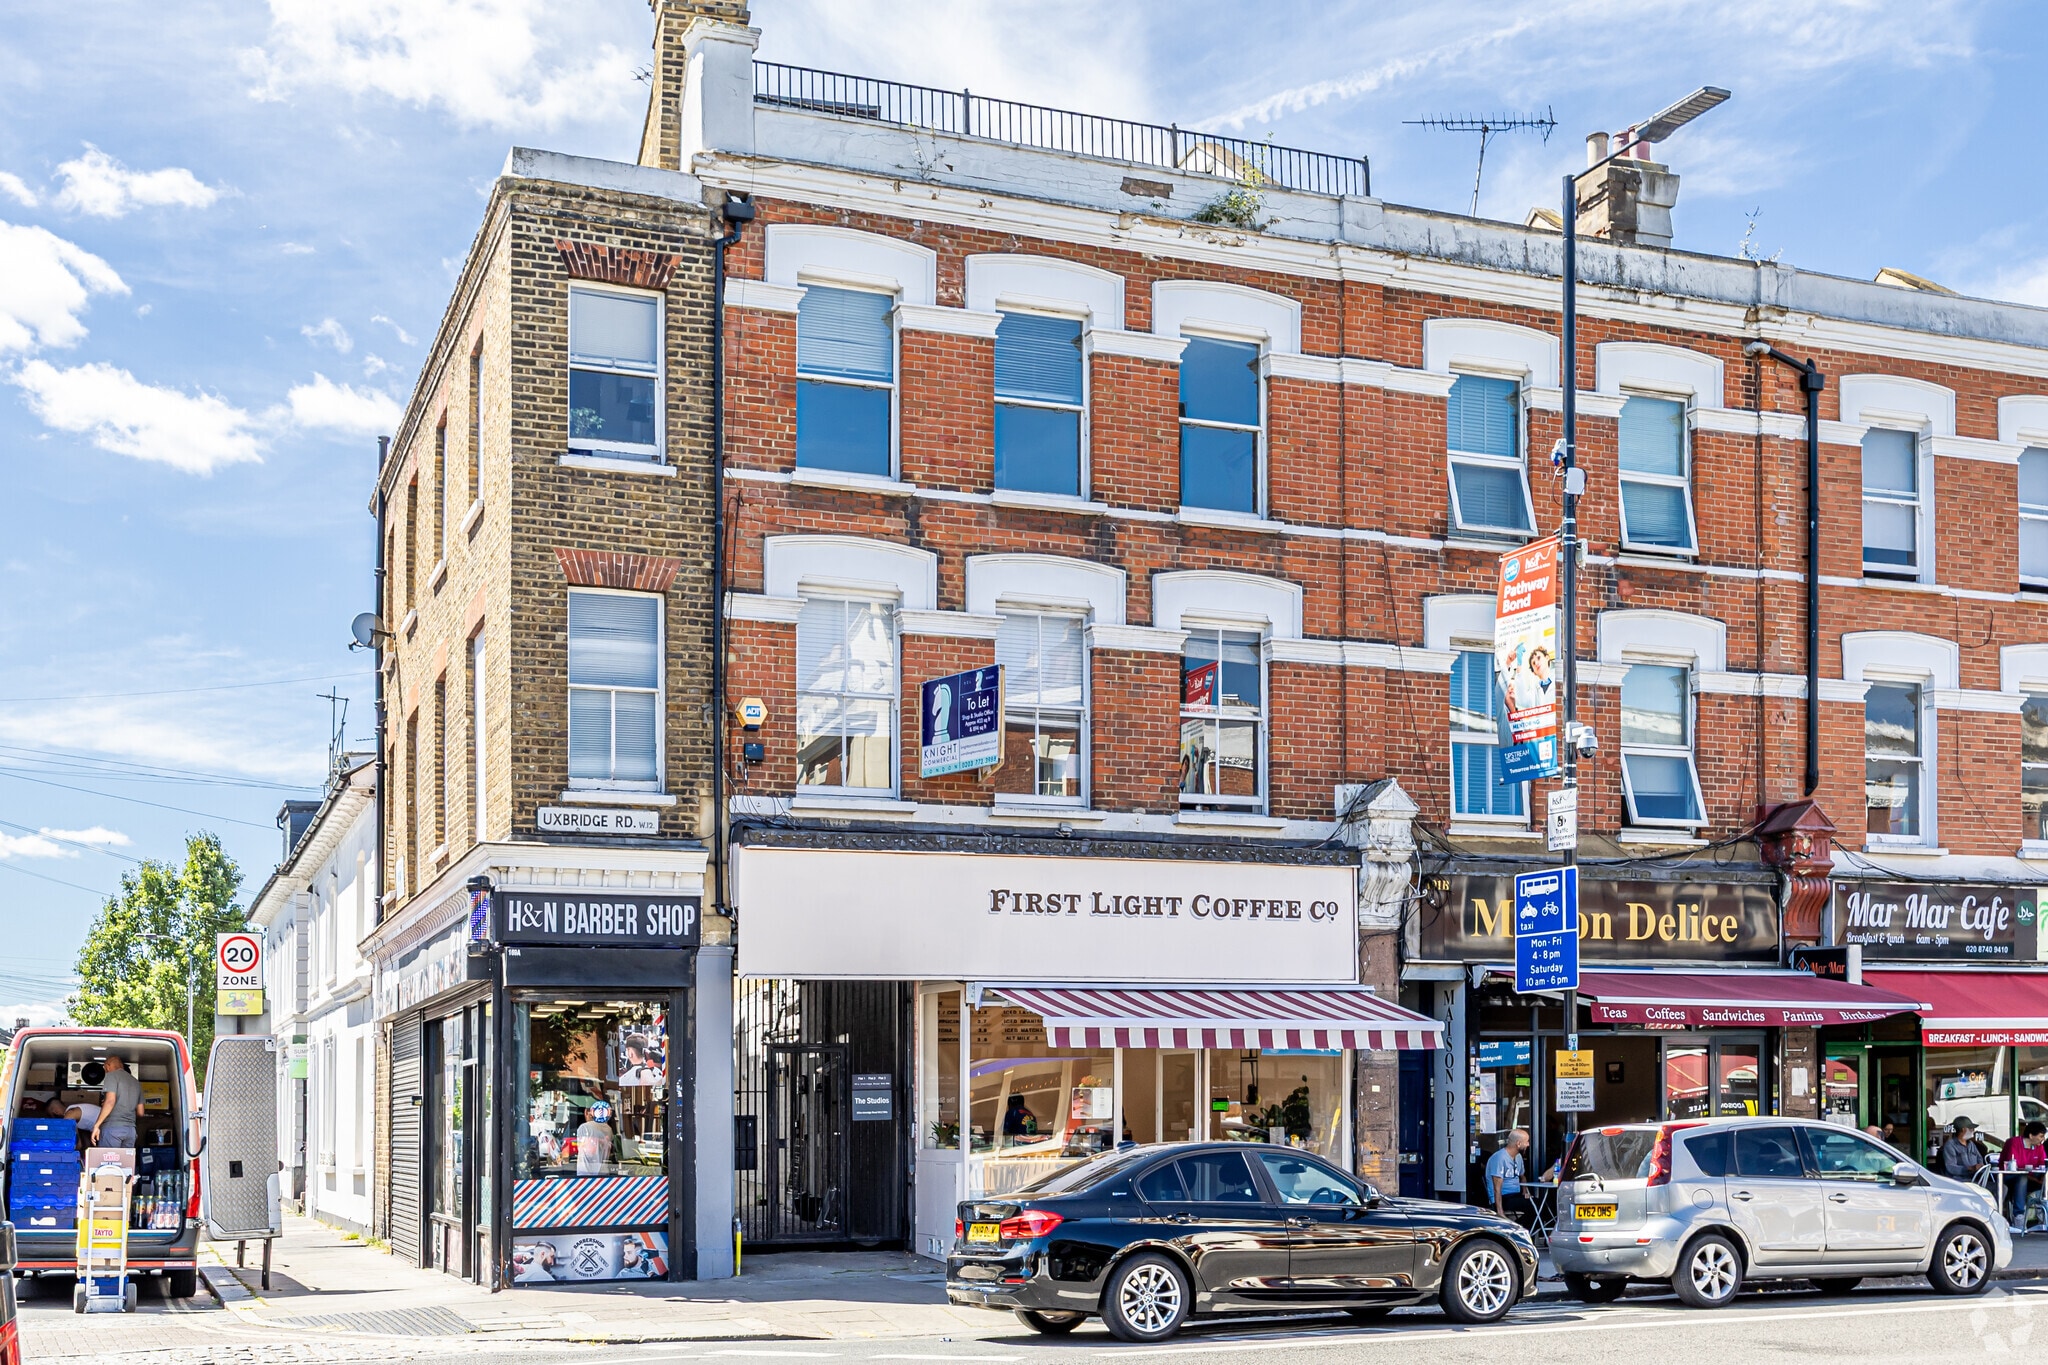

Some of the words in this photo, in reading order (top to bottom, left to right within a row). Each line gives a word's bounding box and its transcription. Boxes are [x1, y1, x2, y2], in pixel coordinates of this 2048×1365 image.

[1503, 576, 1549, 599] Pathway
[1502, 593, 1531, 613] Bond
[967, 698, 976, 710] To
[978, 695, 989, 708] Let
[746, 707, 760, 715] ADT
[924, 743, 957, 759] KNIGHT
[1504, 749, 1529, 759] UPSTREAM
[924, 755, 957, 766] COMMERCIAL
[543, 813, 608, 827] UXBRIDGE
[615, 815, 636, 828] RD.
[990, 889, 1081, 914] FIRST
[1091, 891, 1182, 916] LIGHT
[1191, 894, 1301, 919] COFFEE
[508, 900, 557, 932] H&N
[564, 902, 637, 934] BARBER
[646, 904, 695, 936] SHOP
[1625, 902, 1738, 943] Delice
[1847, 892, 1898, 927] Mar
[1905, 893, 1954, 929] Mar
[1960, 895, 2009, 940] Cafe
[1520, 921, 1534, 930] taxi
[1531, 939, 1547, 948] Mon
[1552, 936, 1562, 945] Fri
[1846, 932, 1878, 946] Breakfast
[1880, 933, 1885, 943] &
[1886, 932, 1904, 946] Lunch
[1916, 933, 1930, 945] 6am
[1935, 934, 1949, 947] 5pm
[226, 948, 253, 962] 20
[1532, 951, 1538, 960] 4
[1543, 950, 1548, 959] 8
[1549, 951, 1560, 960] pm
[1978, 945, 1993, 953] 8740
[1530, 963, 1563, 974] Saturday
[1828, 961, 1845, 974] Mar
[223, 976, 258, 985] ZONE
[1525, 978, 1534, 987] 10
[1551, 975, 1556, 984] 6
[1557, 976, 1568, 986] pm
[1600, 1006, 1628, 1019] Teas
[1645, 1007, 1686, 1020] Coffees
[1702, 1008, 1765, 1022] Sandwiches
[1782, 1010, 1824, 1022] Paninis
[1443, 989, 1454, 1085] MAISON
[1928, 1033, 1975, 1043] BREAKFAST
[1981, 1033, 2009, 1043] LUNCH
[1944, 1125, 1957, 1133] OPE
[1445, 1090, 1455, 1186] DELICE
[94, 1229, 113, 1237] TAYTO
